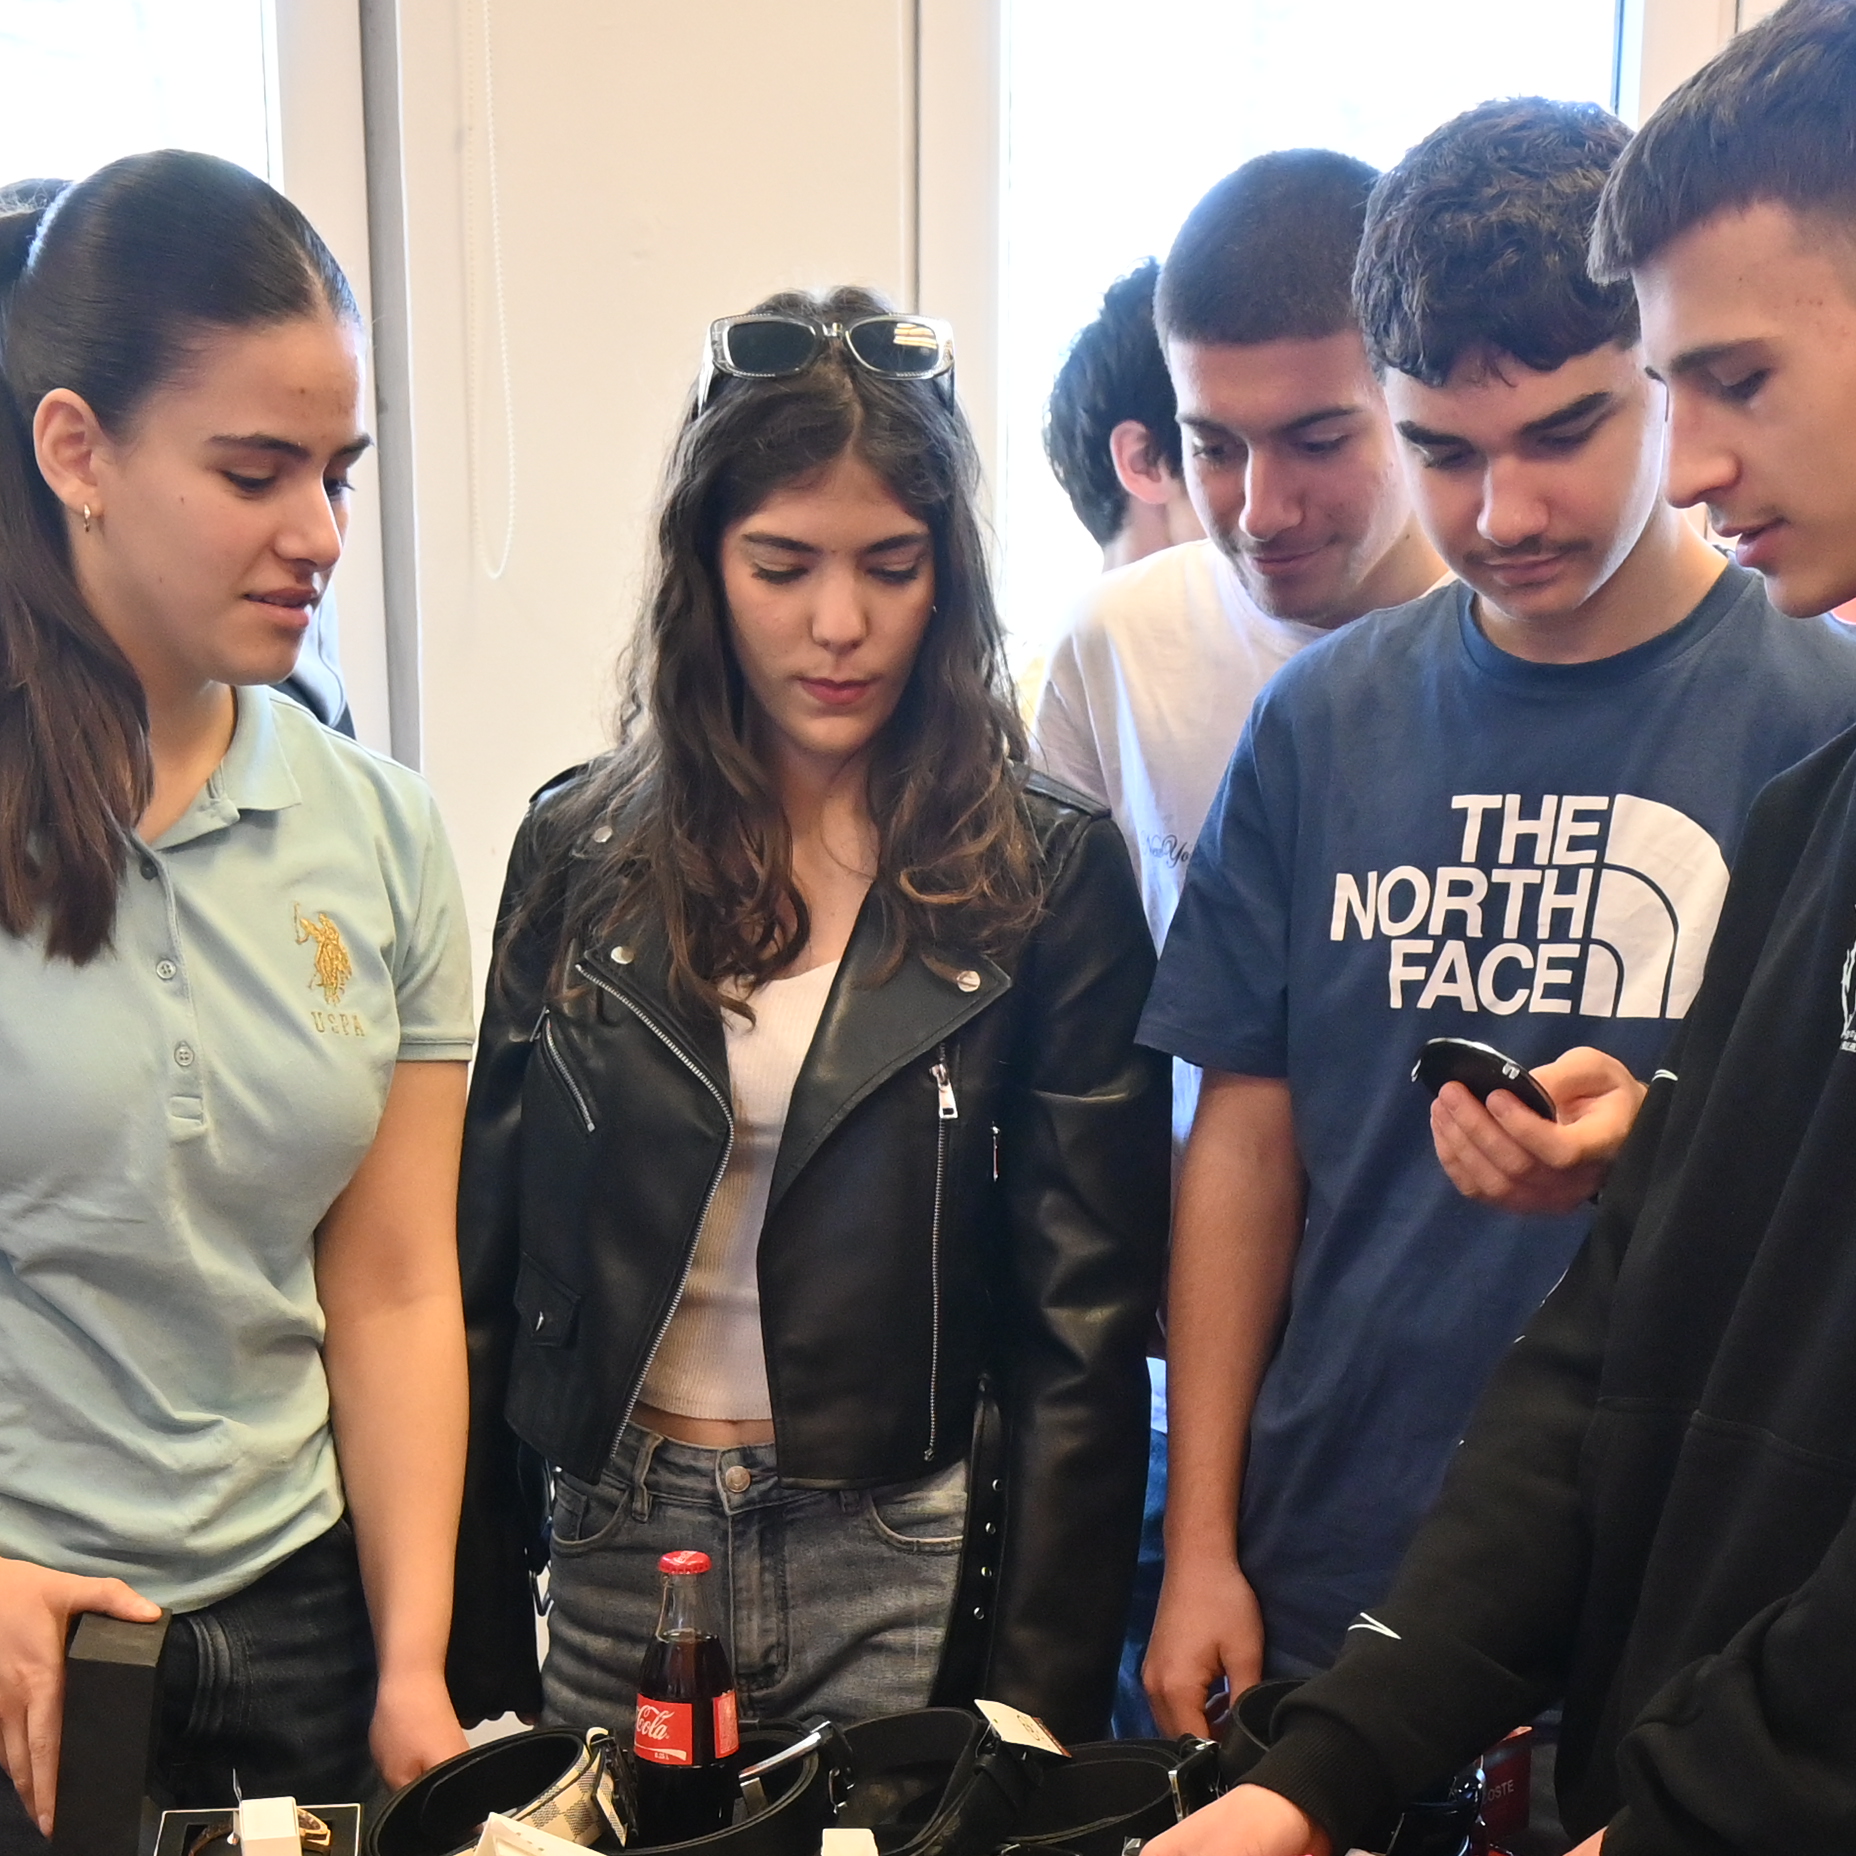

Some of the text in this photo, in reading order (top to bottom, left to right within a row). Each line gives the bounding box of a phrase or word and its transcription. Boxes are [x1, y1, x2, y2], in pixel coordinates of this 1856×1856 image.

[1450, 794, 1610, 867] THE
[1329, 866, 1591, 942] NORTH
[1388, 940, 1578, 1016] FACE
